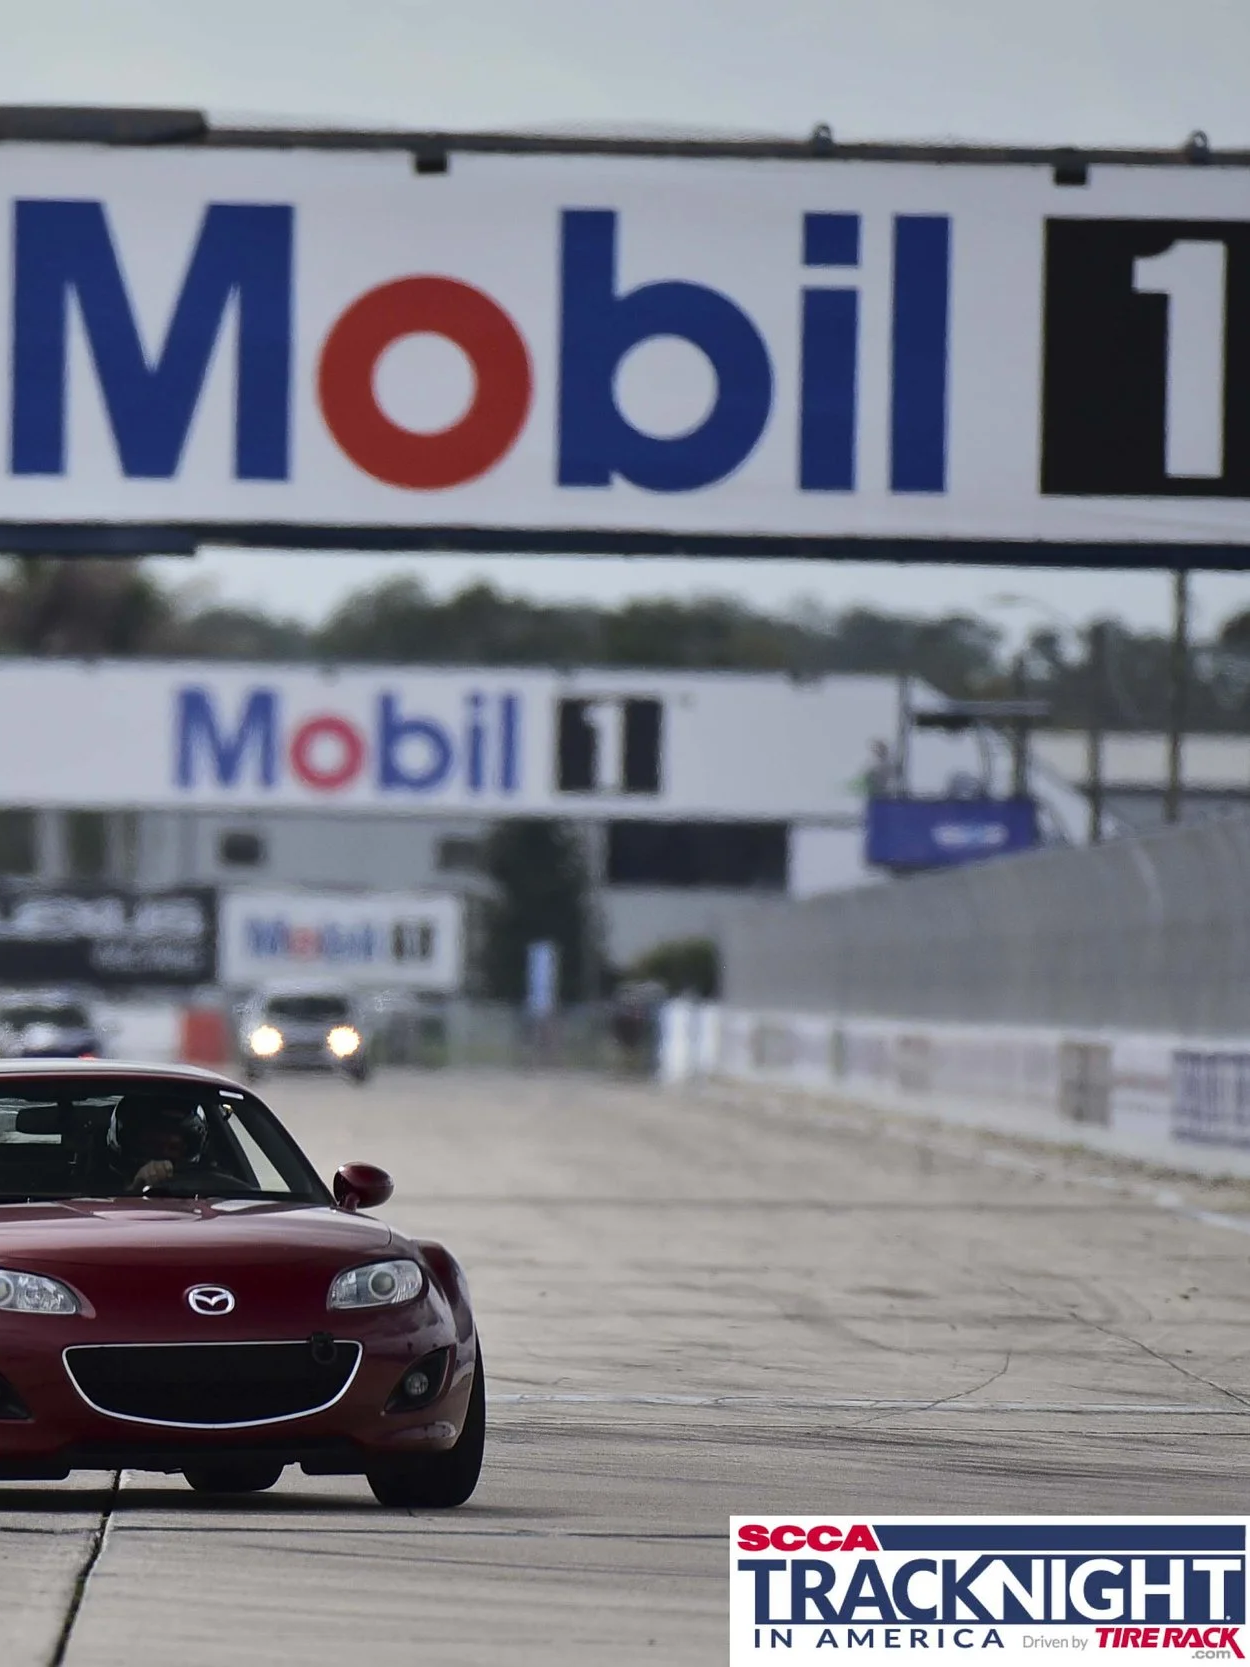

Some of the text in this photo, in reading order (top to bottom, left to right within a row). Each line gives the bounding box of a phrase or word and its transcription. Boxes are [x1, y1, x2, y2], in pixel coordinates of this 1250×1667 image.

[7, 197, 1227, 494] Mobil 1
[174, 684, 520, 794] Mobil
